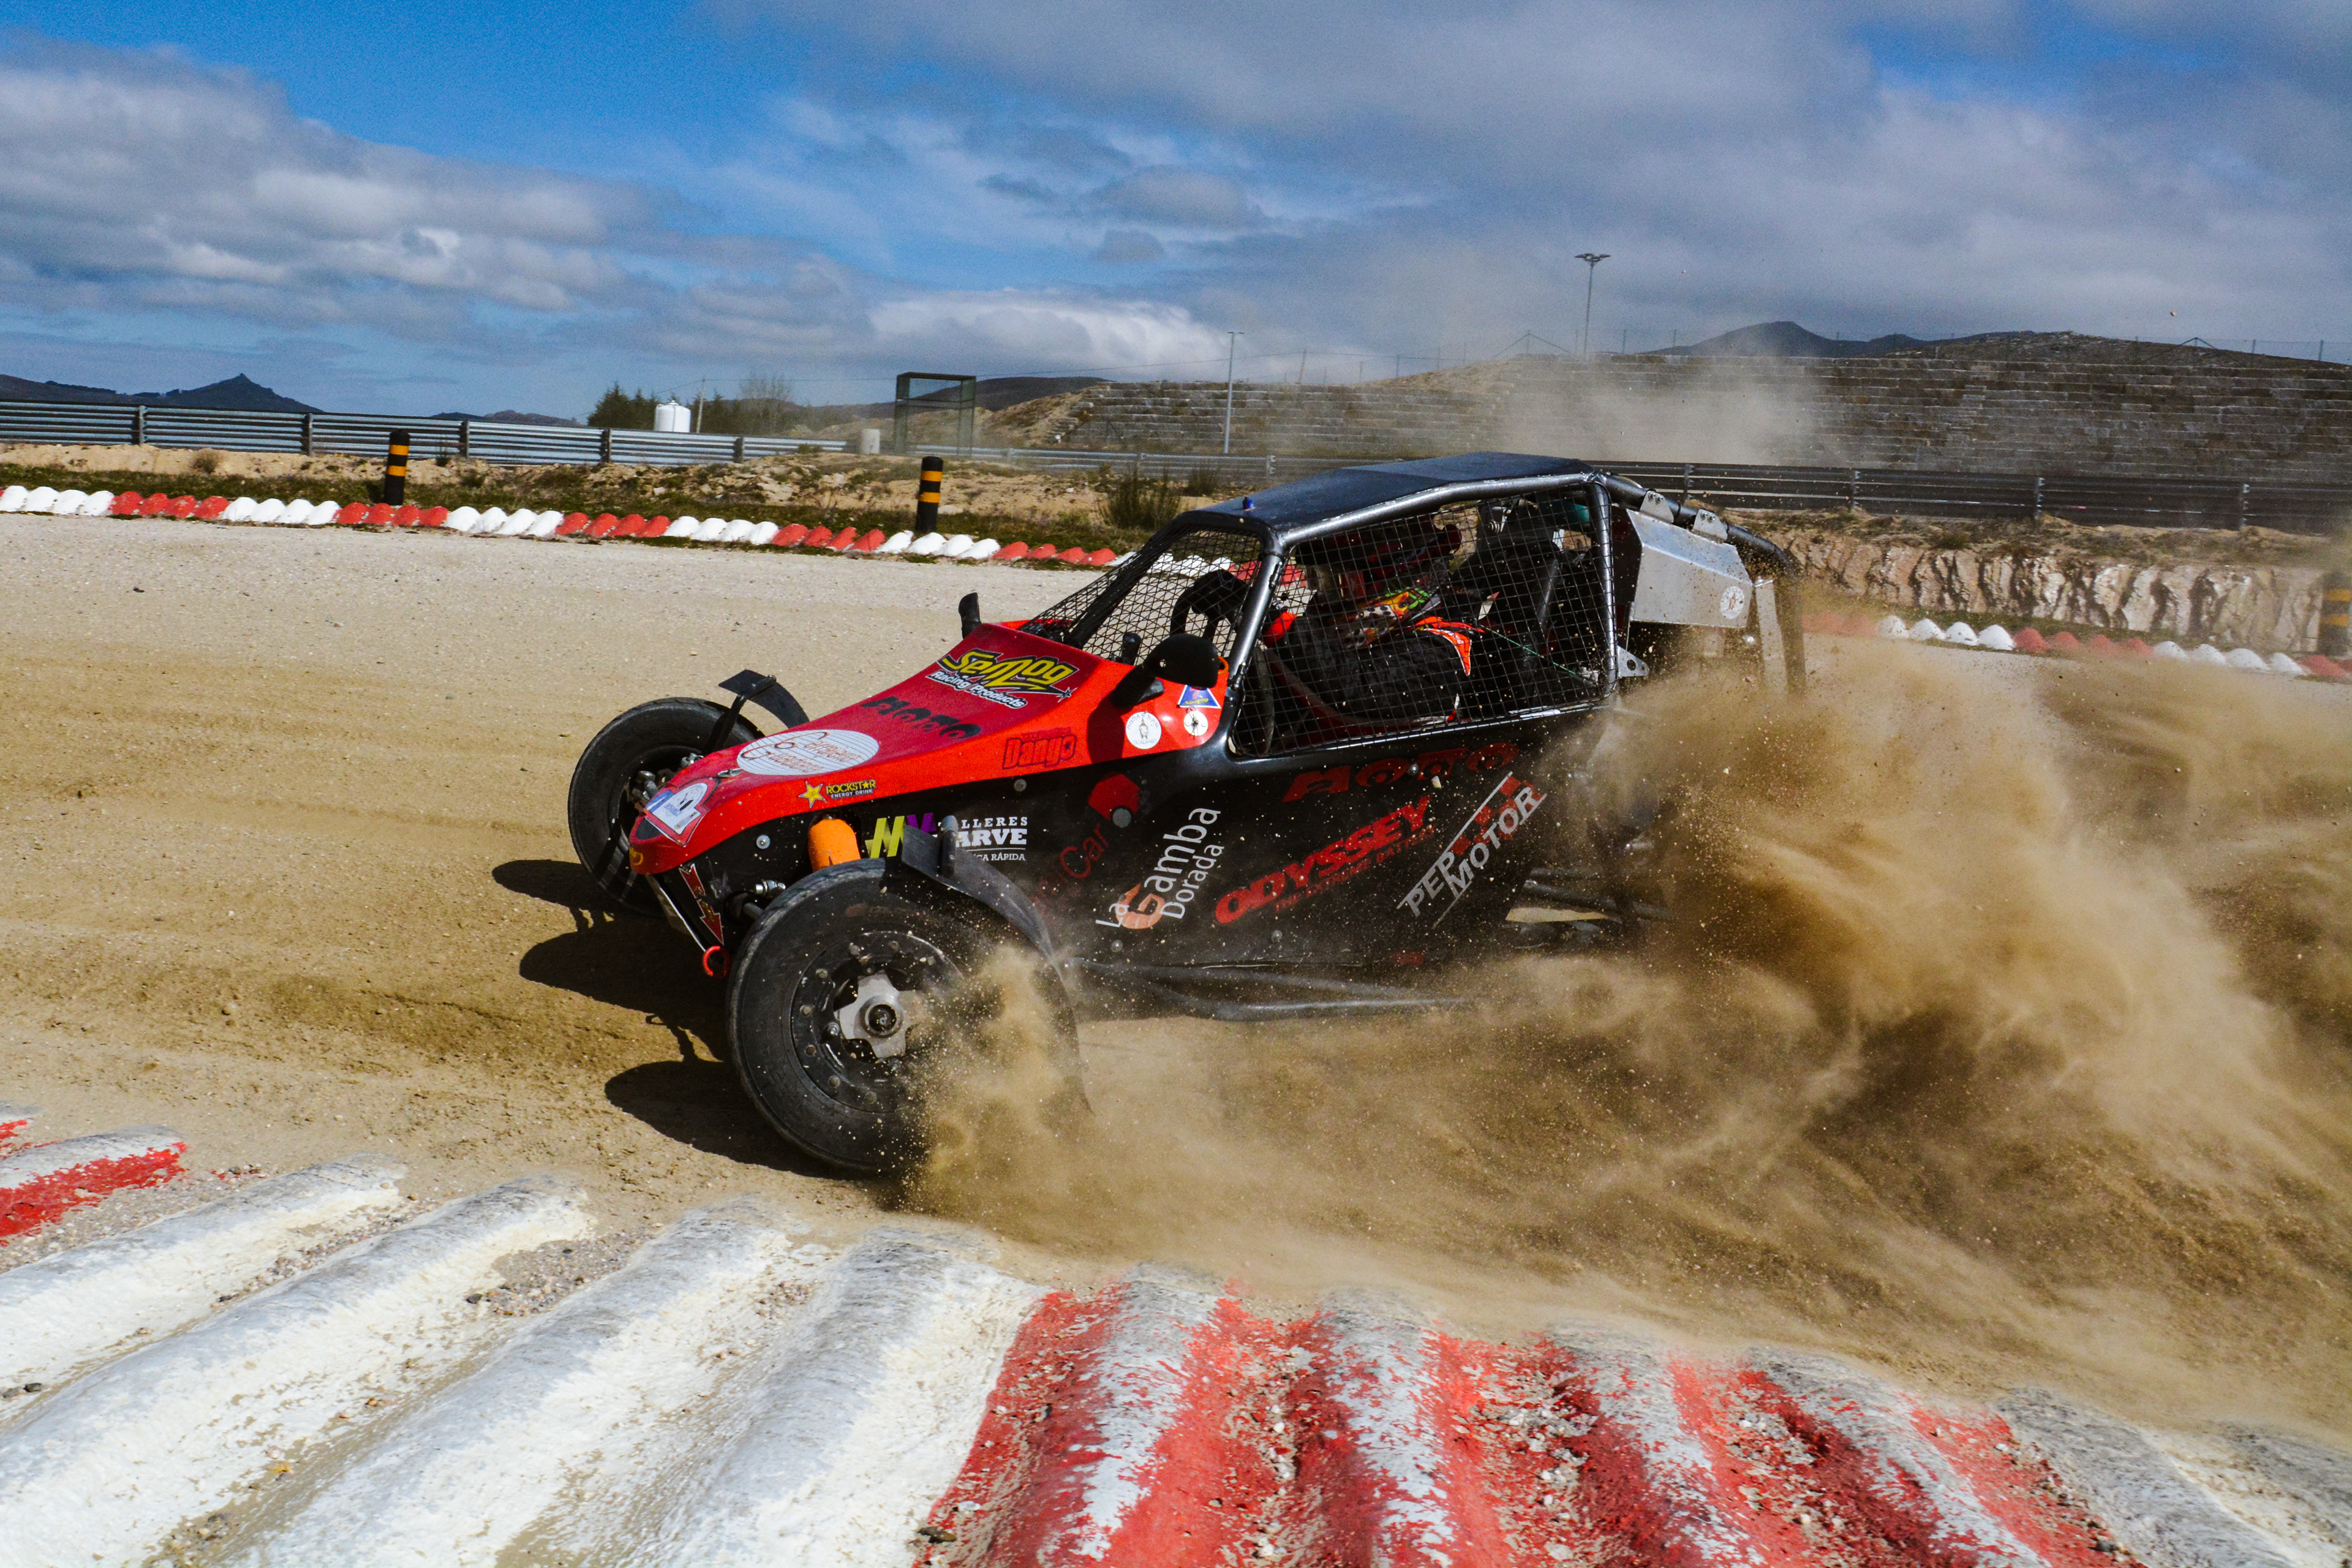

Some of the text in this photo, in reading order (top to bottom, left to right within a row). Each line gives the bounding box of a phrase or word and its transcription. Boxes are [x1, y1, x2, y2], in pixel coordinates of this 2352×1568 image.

[930, 670, 1027, 707] Racing Products
[932, 828, 1028, 848] ARVE
[991, 853, 1026, 862] RÁPIDA
[1215, 794, 1433, 924] ODYSSEY
[1450, 786, 1547, 900] MOTOR
[1159, 844, 1225, 919] Dorada
[1403, 851, 1455, 918] PEP
[1095, 902, 1130, 928] La
